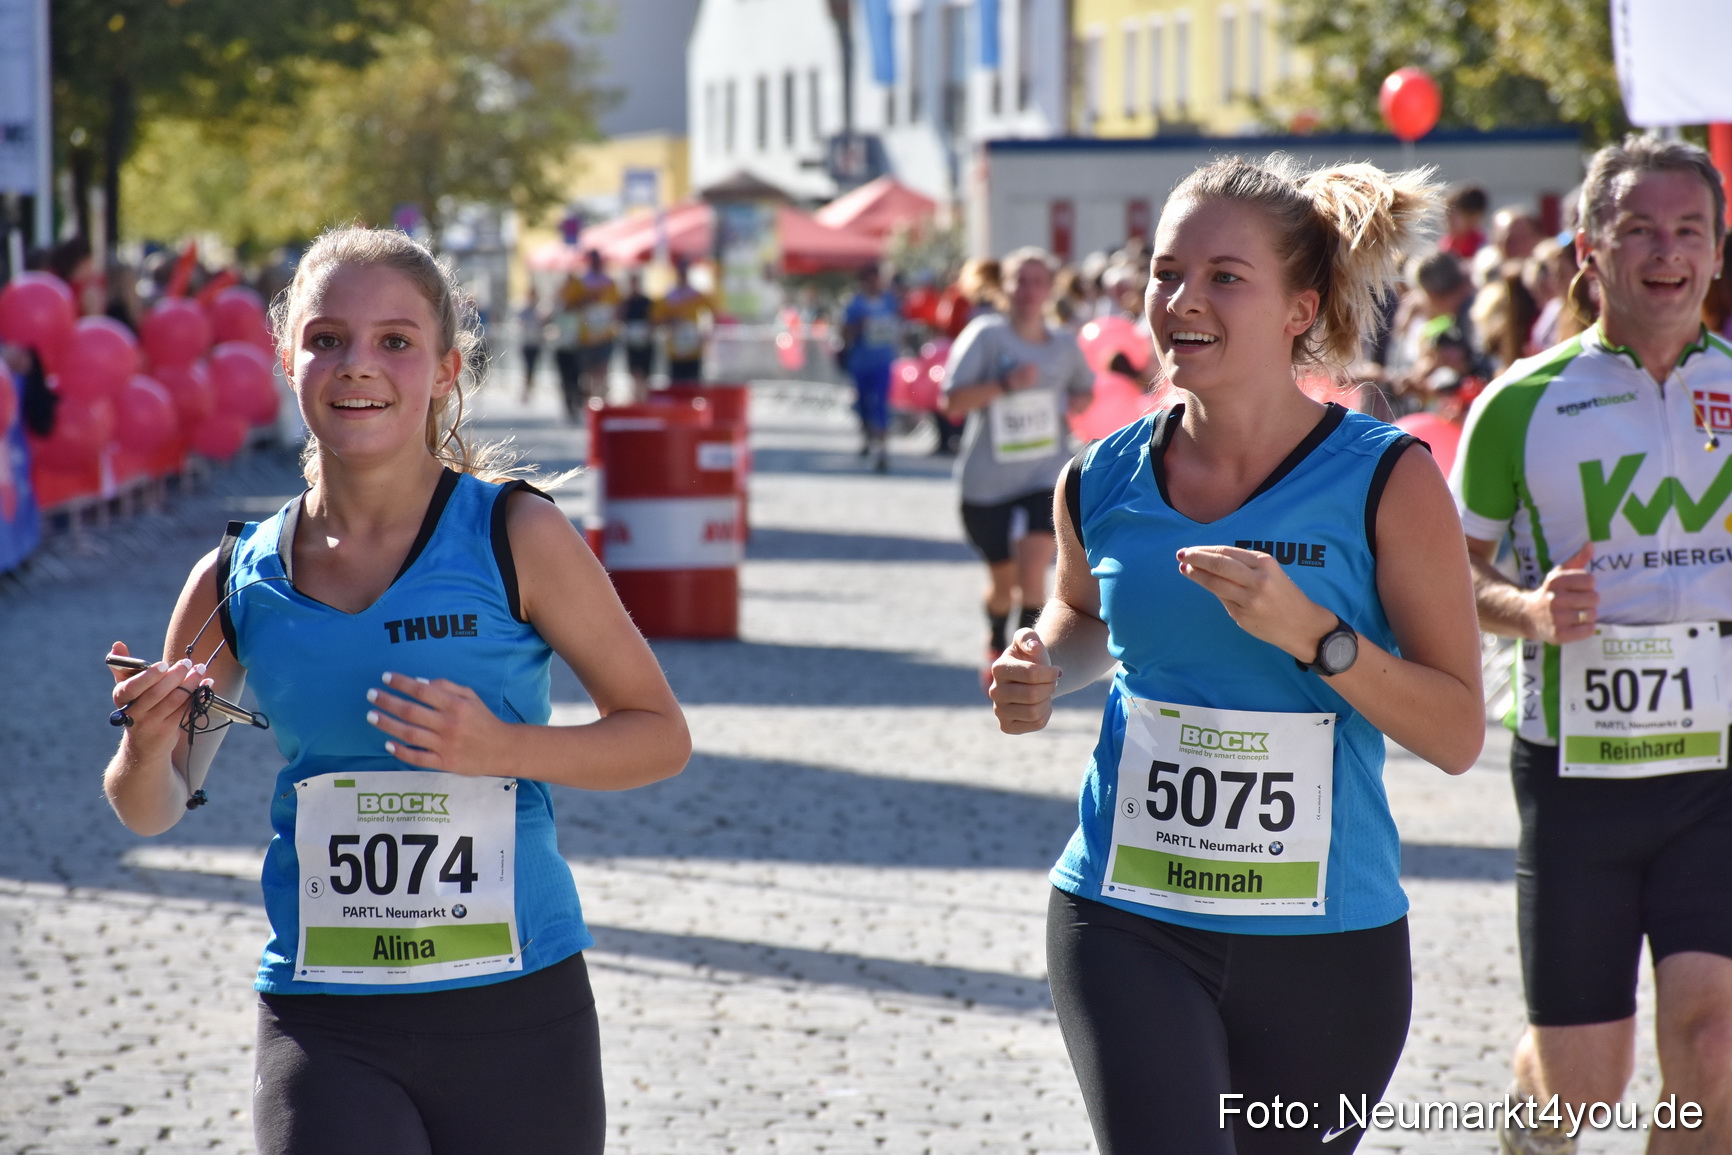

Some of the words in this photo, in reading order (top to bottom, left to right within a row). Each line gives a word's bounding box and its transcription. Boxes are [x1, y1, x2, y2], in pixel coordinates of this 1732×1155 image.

[1556, 391, 1637, 416] smartblock
[1589, 552, 1633, 573] KW
[384, 614, 478, 644] THULE
[1602, 638, 1674, 655] BOCK
[1585, 667, 1694, 713] 5071
[1594, 720, 1627, 731] PARTL
[1628, 719, 1678, 730] Neumarkt
[1178, 723, 1270, 753] BOCK
[1599, 738, 1686, 761] Reinhard
[1178, 746, 1203, 757] inspired
[1203, 750, 1213, 759] by
[1213, 752, 1236, 760] smart
[1237, 753, 1270, 762] concepts
[357, 792, 450, 816] BOCK
[1145, 759, 1296, 833] 5075
[356, 815, 385, 824] inspired
[386, 815, 395, 824] by
[396, 815, 416, 823] smart
[417, 815, 450, 824] concepts
[1126, 802, 1135, 815] S
[1155, 831, 1197, 849] PARTL
[1199, 838, 1264, 854] Neumarkt
[328, 833, 479, 896] 5074
[310, 881, 319, 894] S
[1166, 860, 1263, 893] Hannah
[342, 906, 383, 919] PARTL
[385, 906, 447, 919] Neumarkt
[372, 934, 436, 961] Alina
